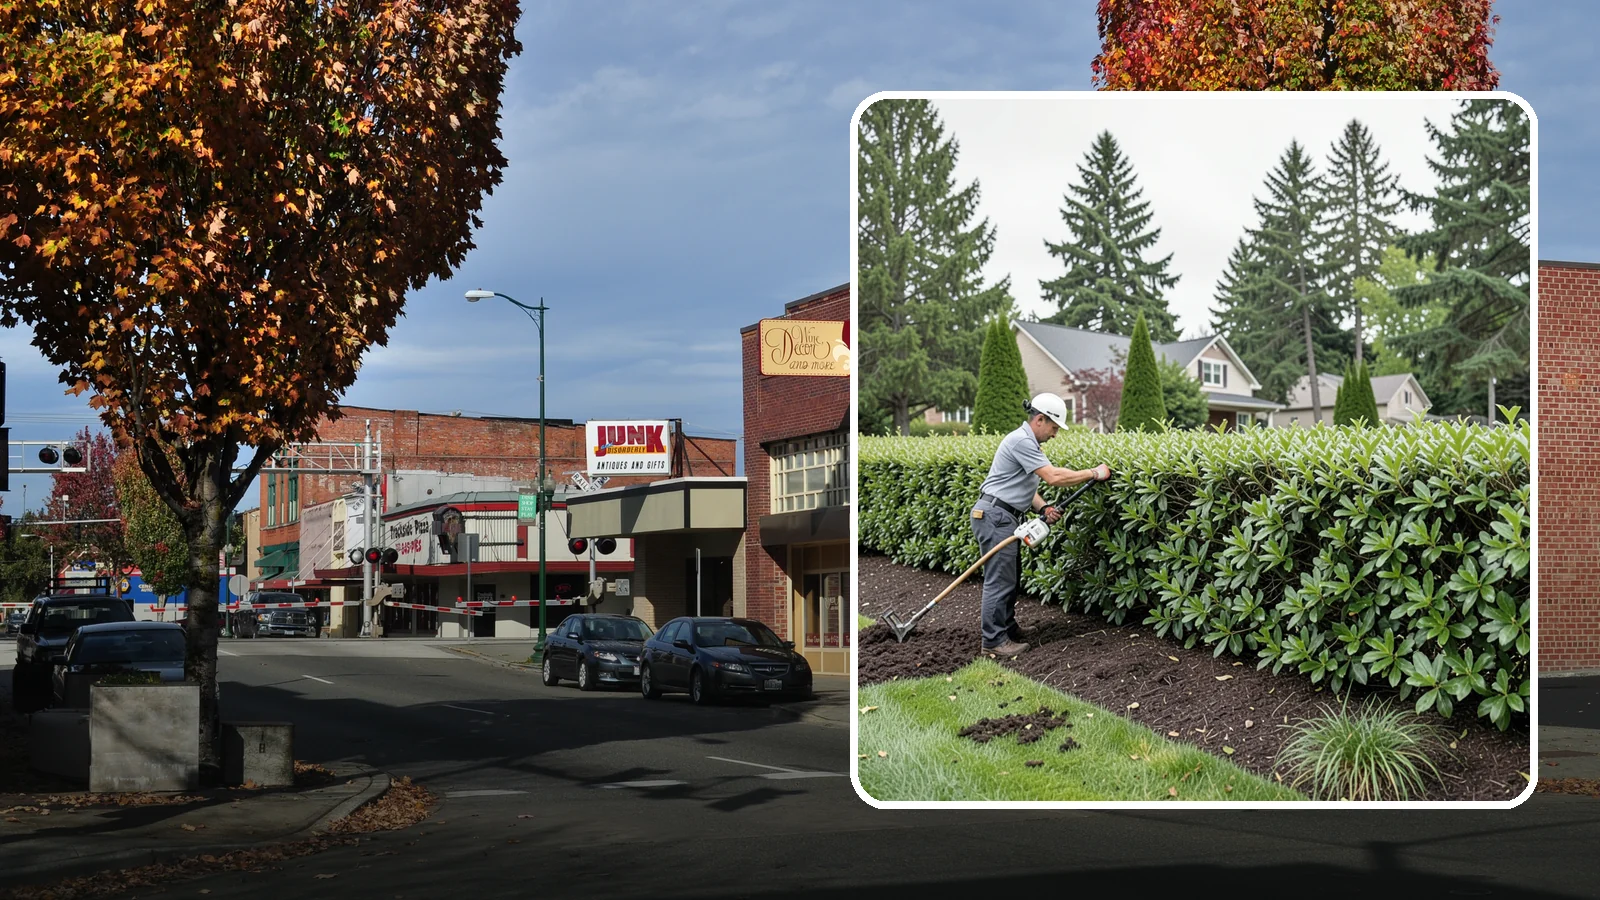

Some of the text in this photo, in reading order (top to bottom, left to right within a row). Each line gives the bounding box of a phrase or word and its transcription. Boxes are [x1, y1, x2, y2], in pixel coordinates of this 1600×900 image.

[595, 425, 665, 457] JUNK
[607, 446, 646, 454] DISORDERLY
[597, 460, 665, 470] ANTIQUES AND GIFTS
[414, 519, 429, 535] Pizza
